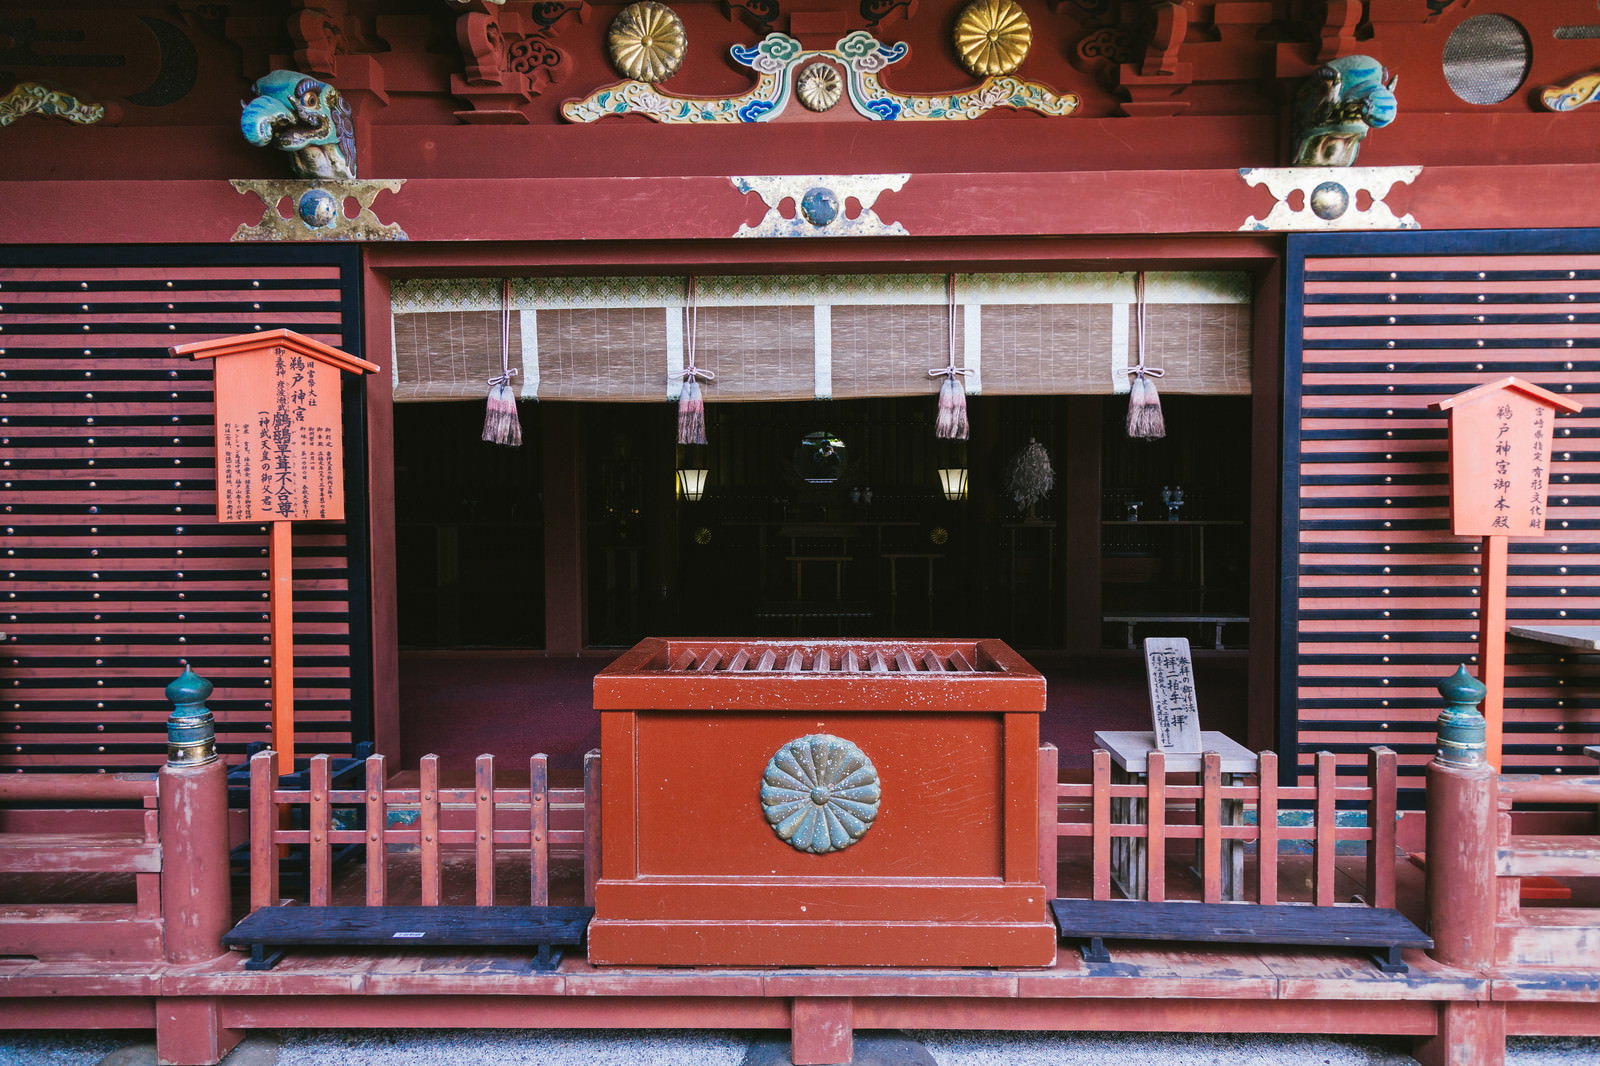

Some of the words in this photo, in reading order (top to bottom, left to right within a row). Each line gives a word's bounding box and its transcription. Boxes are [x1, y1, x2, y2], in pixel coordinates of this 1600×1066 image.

[290, 356, 307, 422] 鵜戸神宮
[307, 362, 318, 407] 旧官幣大社
[258, 411, 272, 512] (神武天皇の御父君)
[1492, 404, 1513, 529] 鵜戸神宮御本殿
[1532, 407, 1544, 462] 宮崎県指定
[1529, 466, 1544, 529] 有形文化財
[1163, 648, 1185, 732] 二拝二拍手一拝
[1178, 656, 1196, 713] 参拝の御作法
